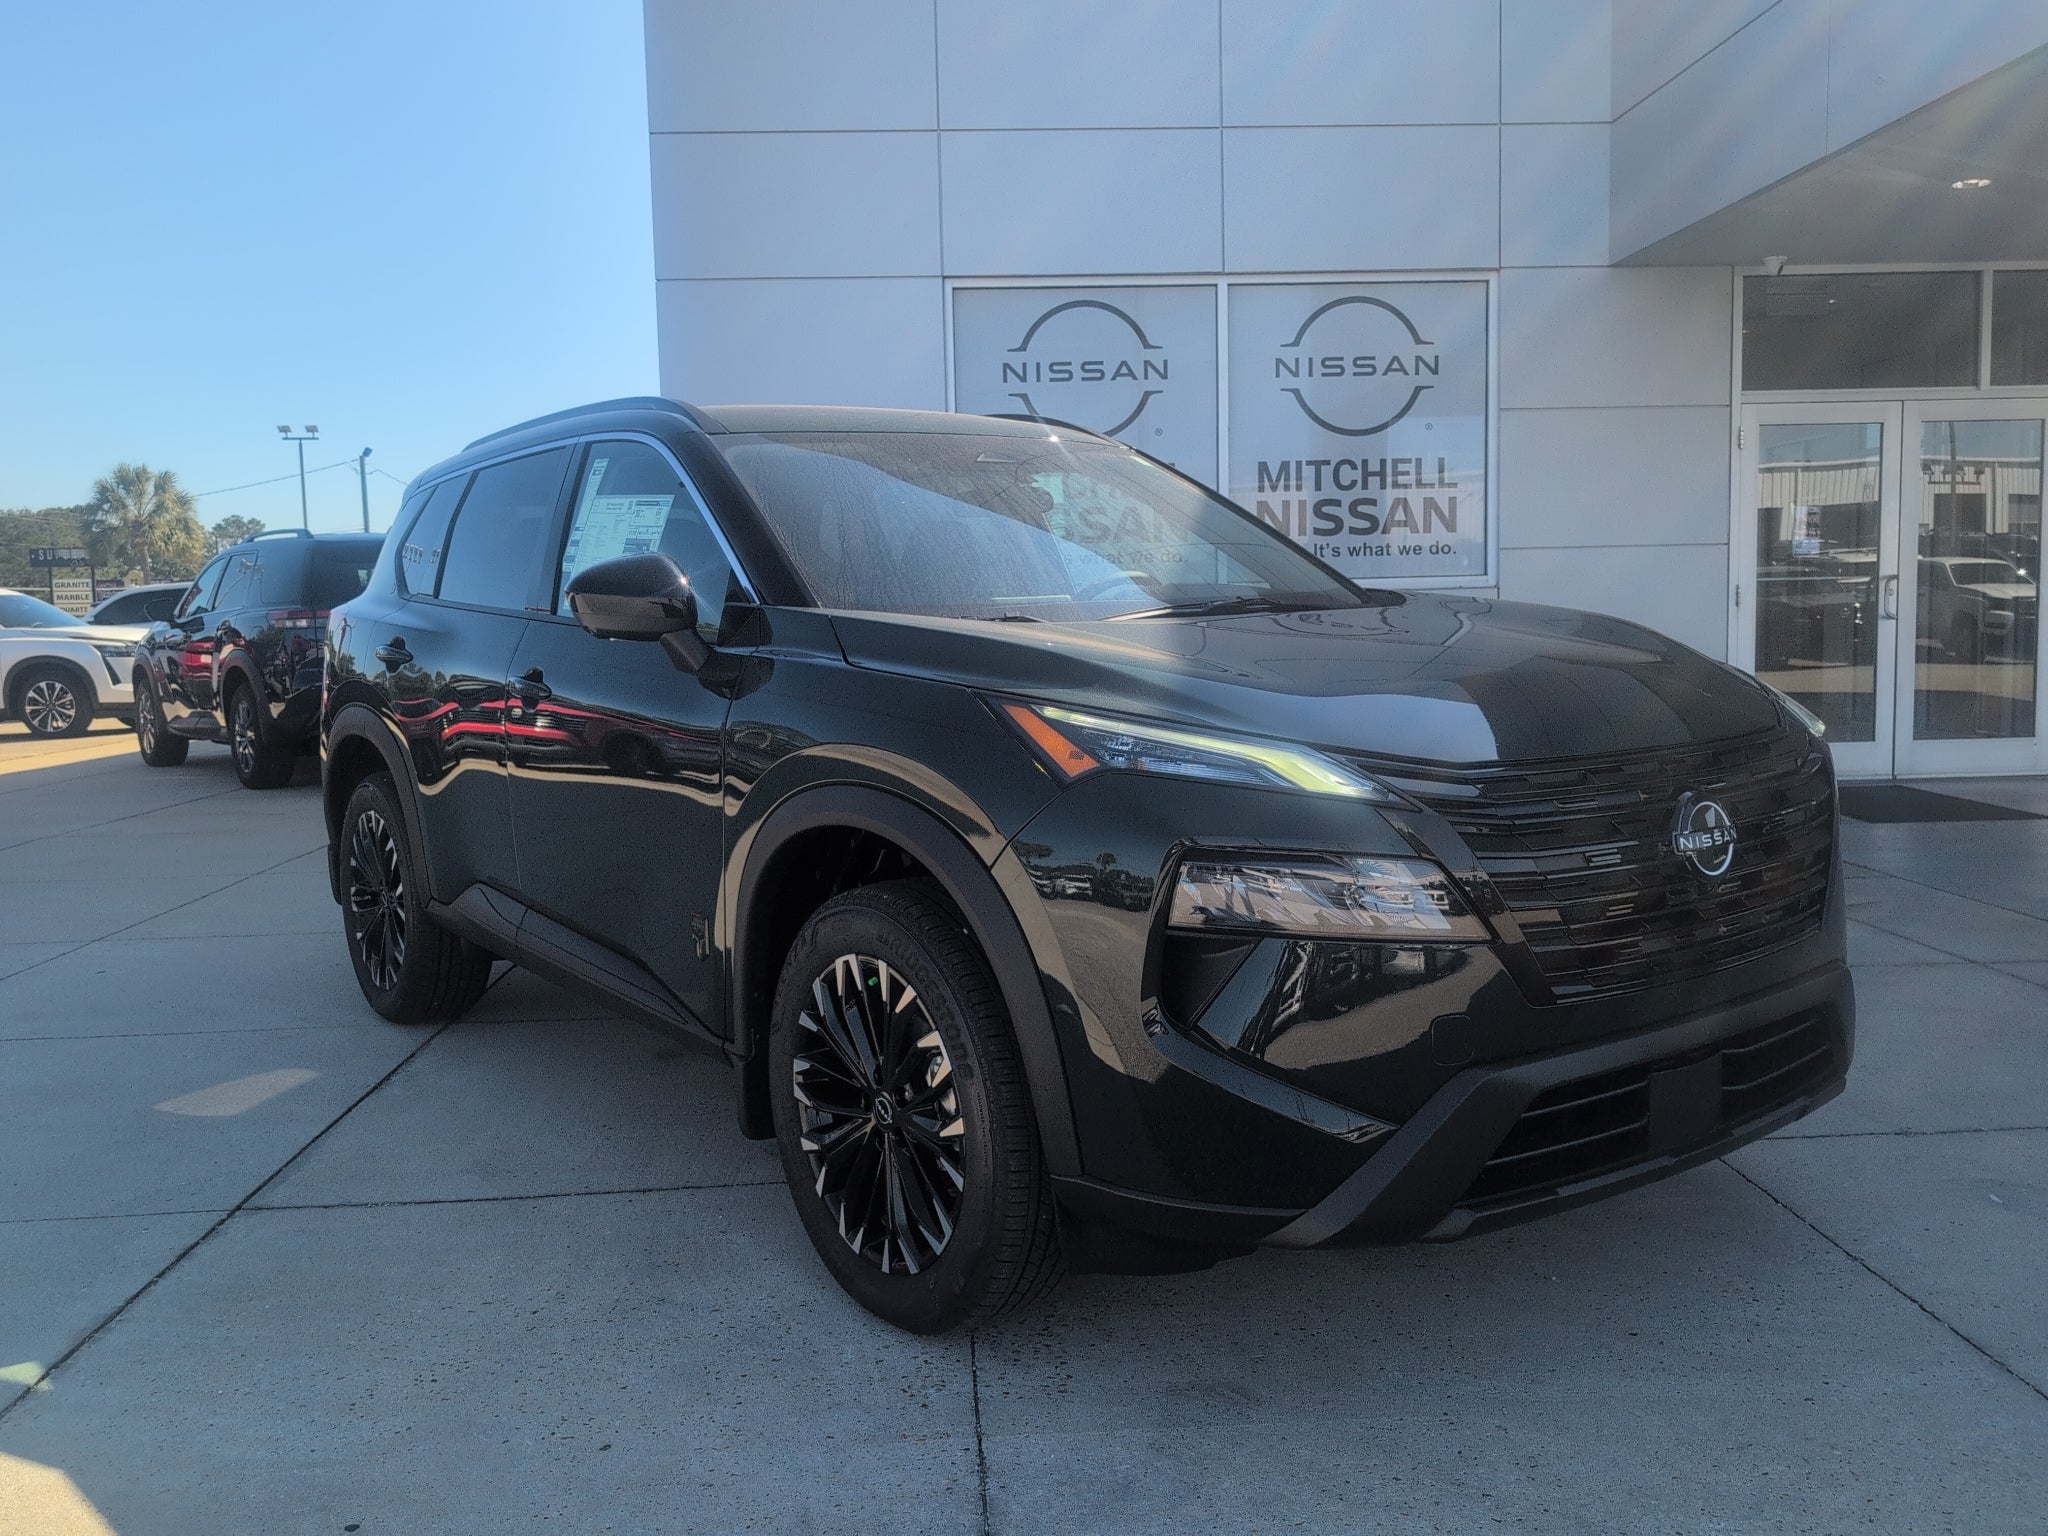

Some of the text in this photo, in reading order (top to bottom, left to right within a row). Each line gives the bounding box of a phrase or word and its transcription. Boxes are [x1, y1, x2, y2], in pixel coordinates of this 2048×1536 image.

[1002, 359, 1169, 384] NISSAN
[1275, 354, 1440, 379] NISSAN
[1257, 456, 1458, 493] MITCHELL
[1256, 496, 1458, 537] NISSAN
[1313, 541, 1458, 557] It's what we do.
[1679, 828, 1737, 850] NISSAN
